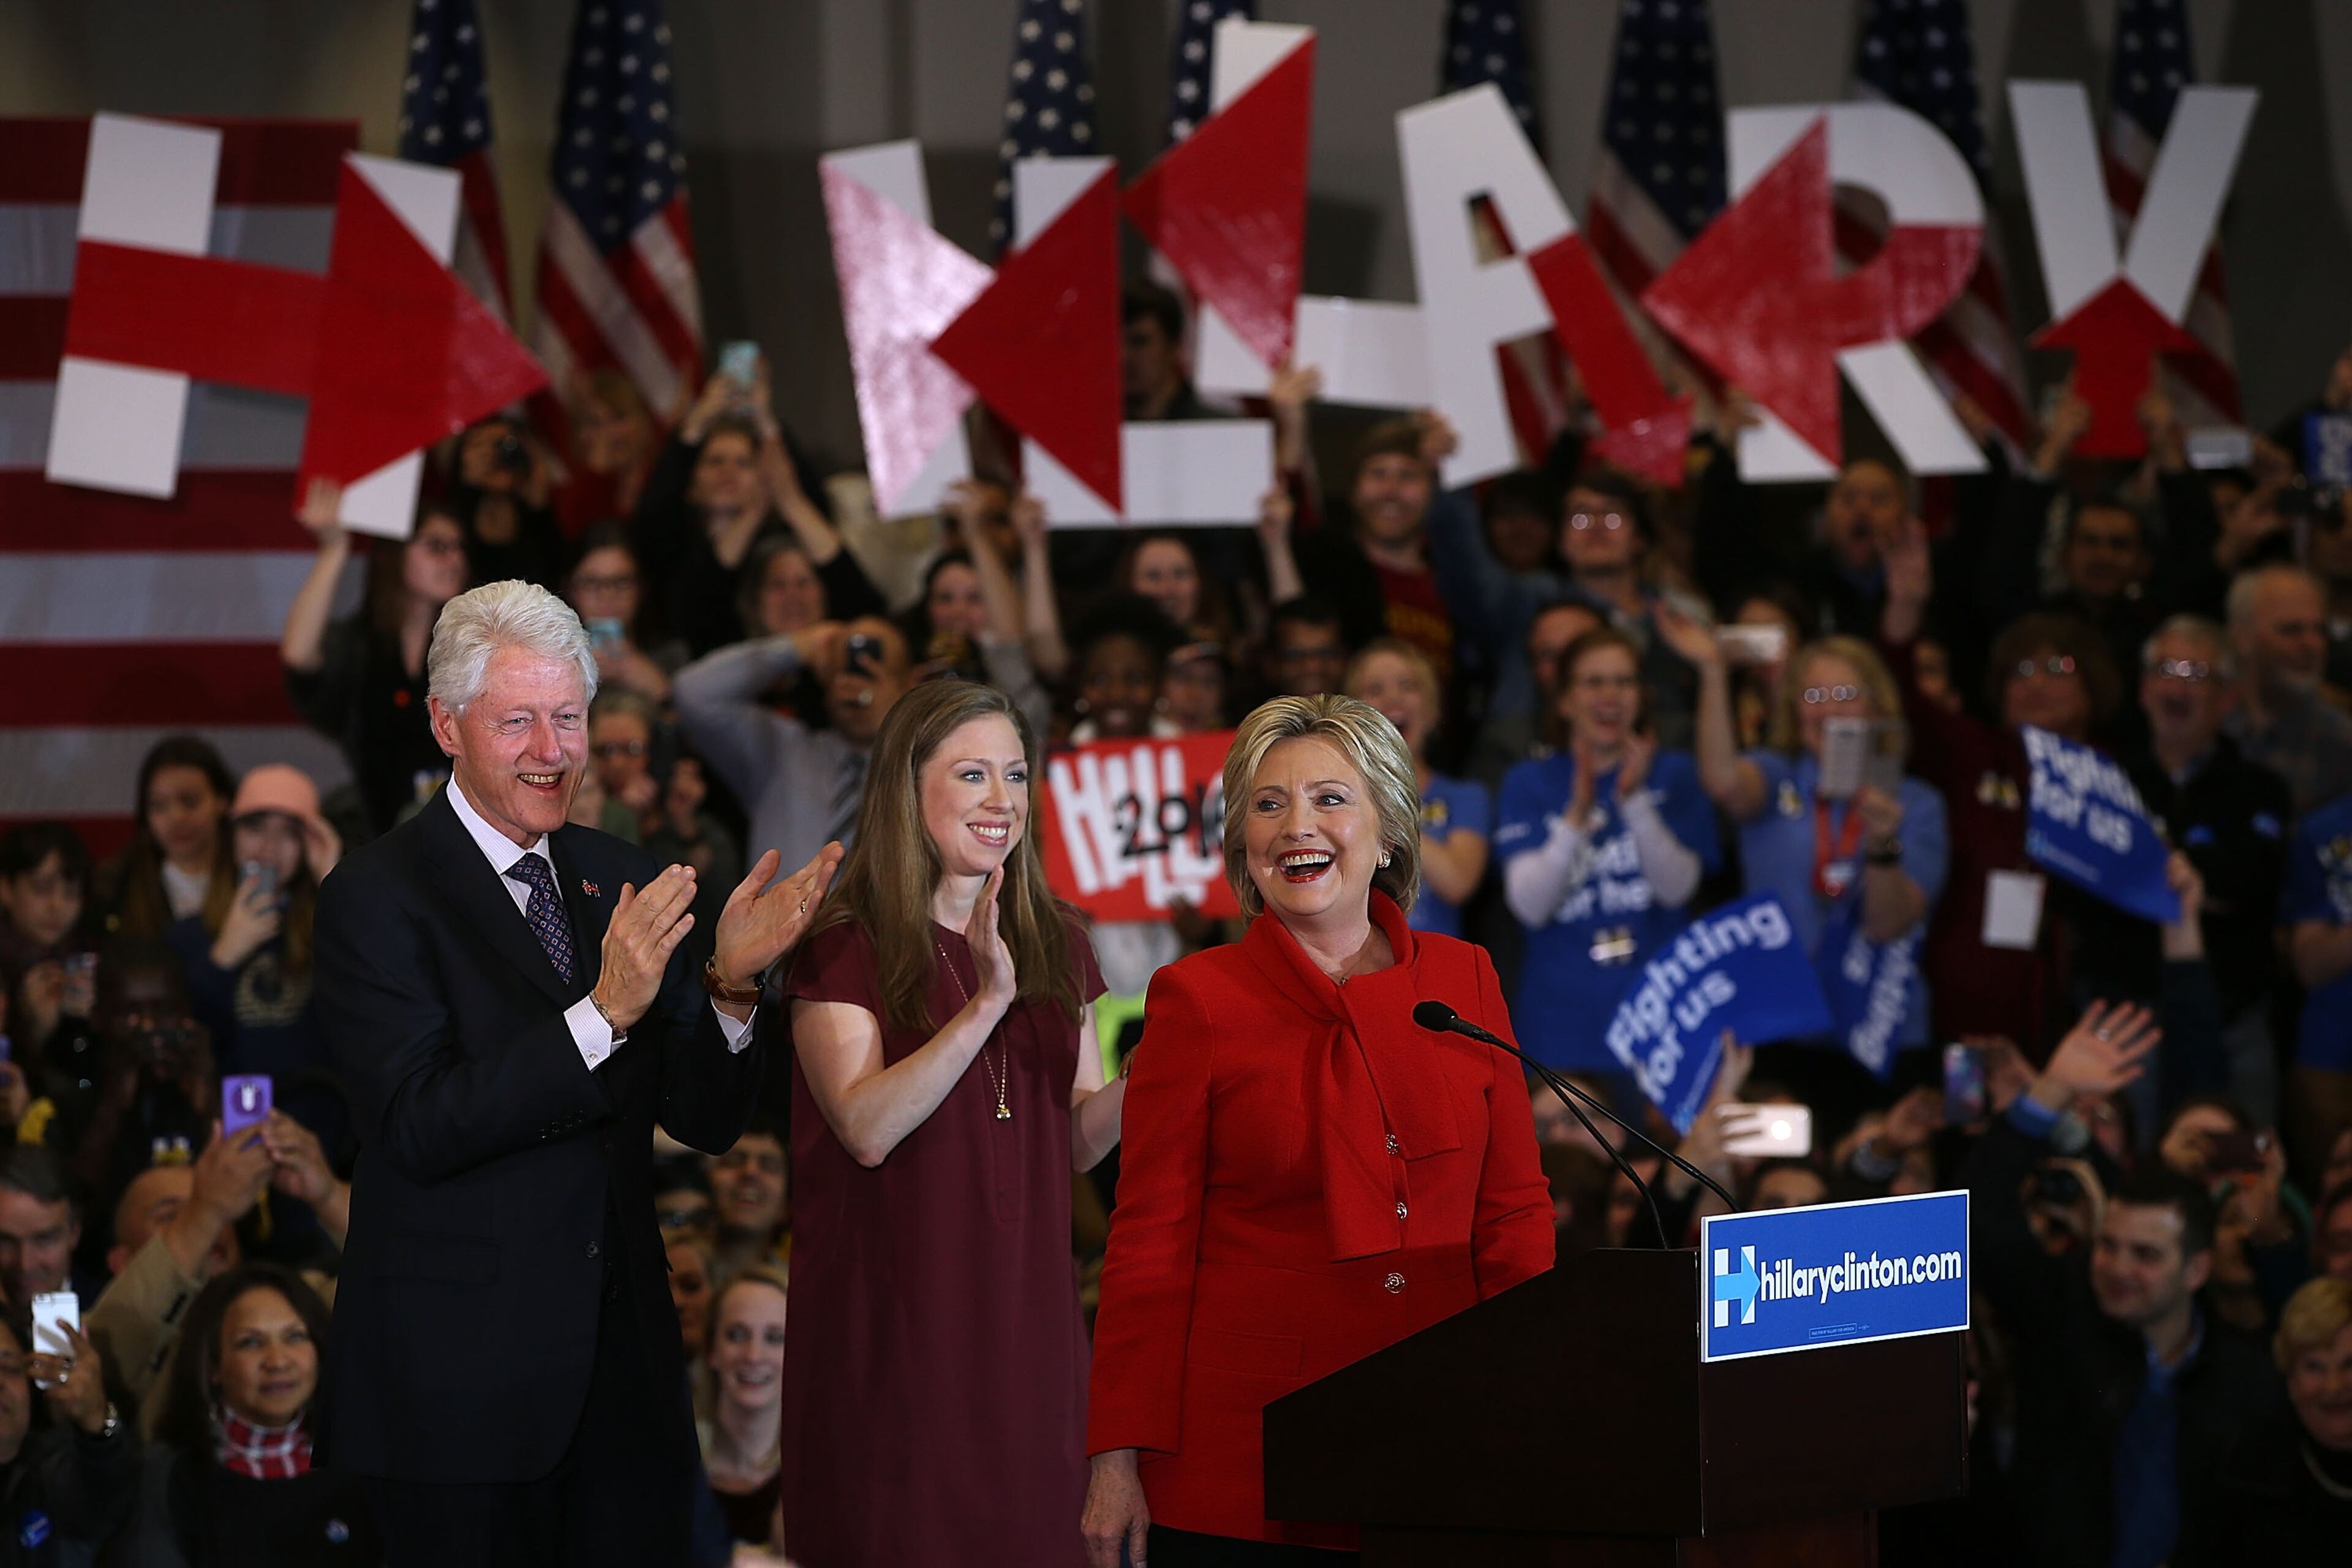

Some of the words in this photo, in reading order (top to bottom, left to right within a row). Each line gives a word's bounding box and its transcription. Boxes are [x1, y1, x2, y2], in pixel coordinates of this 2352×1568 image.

[2030, 767, 2082, 830] for
[2086, 804, 2133, 855] us
[1605, 900, 1792, 1069] Fighting
[1634, 1020, 1684, 1104] for
[1673, 970, 1737, 1032] us
[1761, 1251, 1961, 1304] hillaryclinton.com
